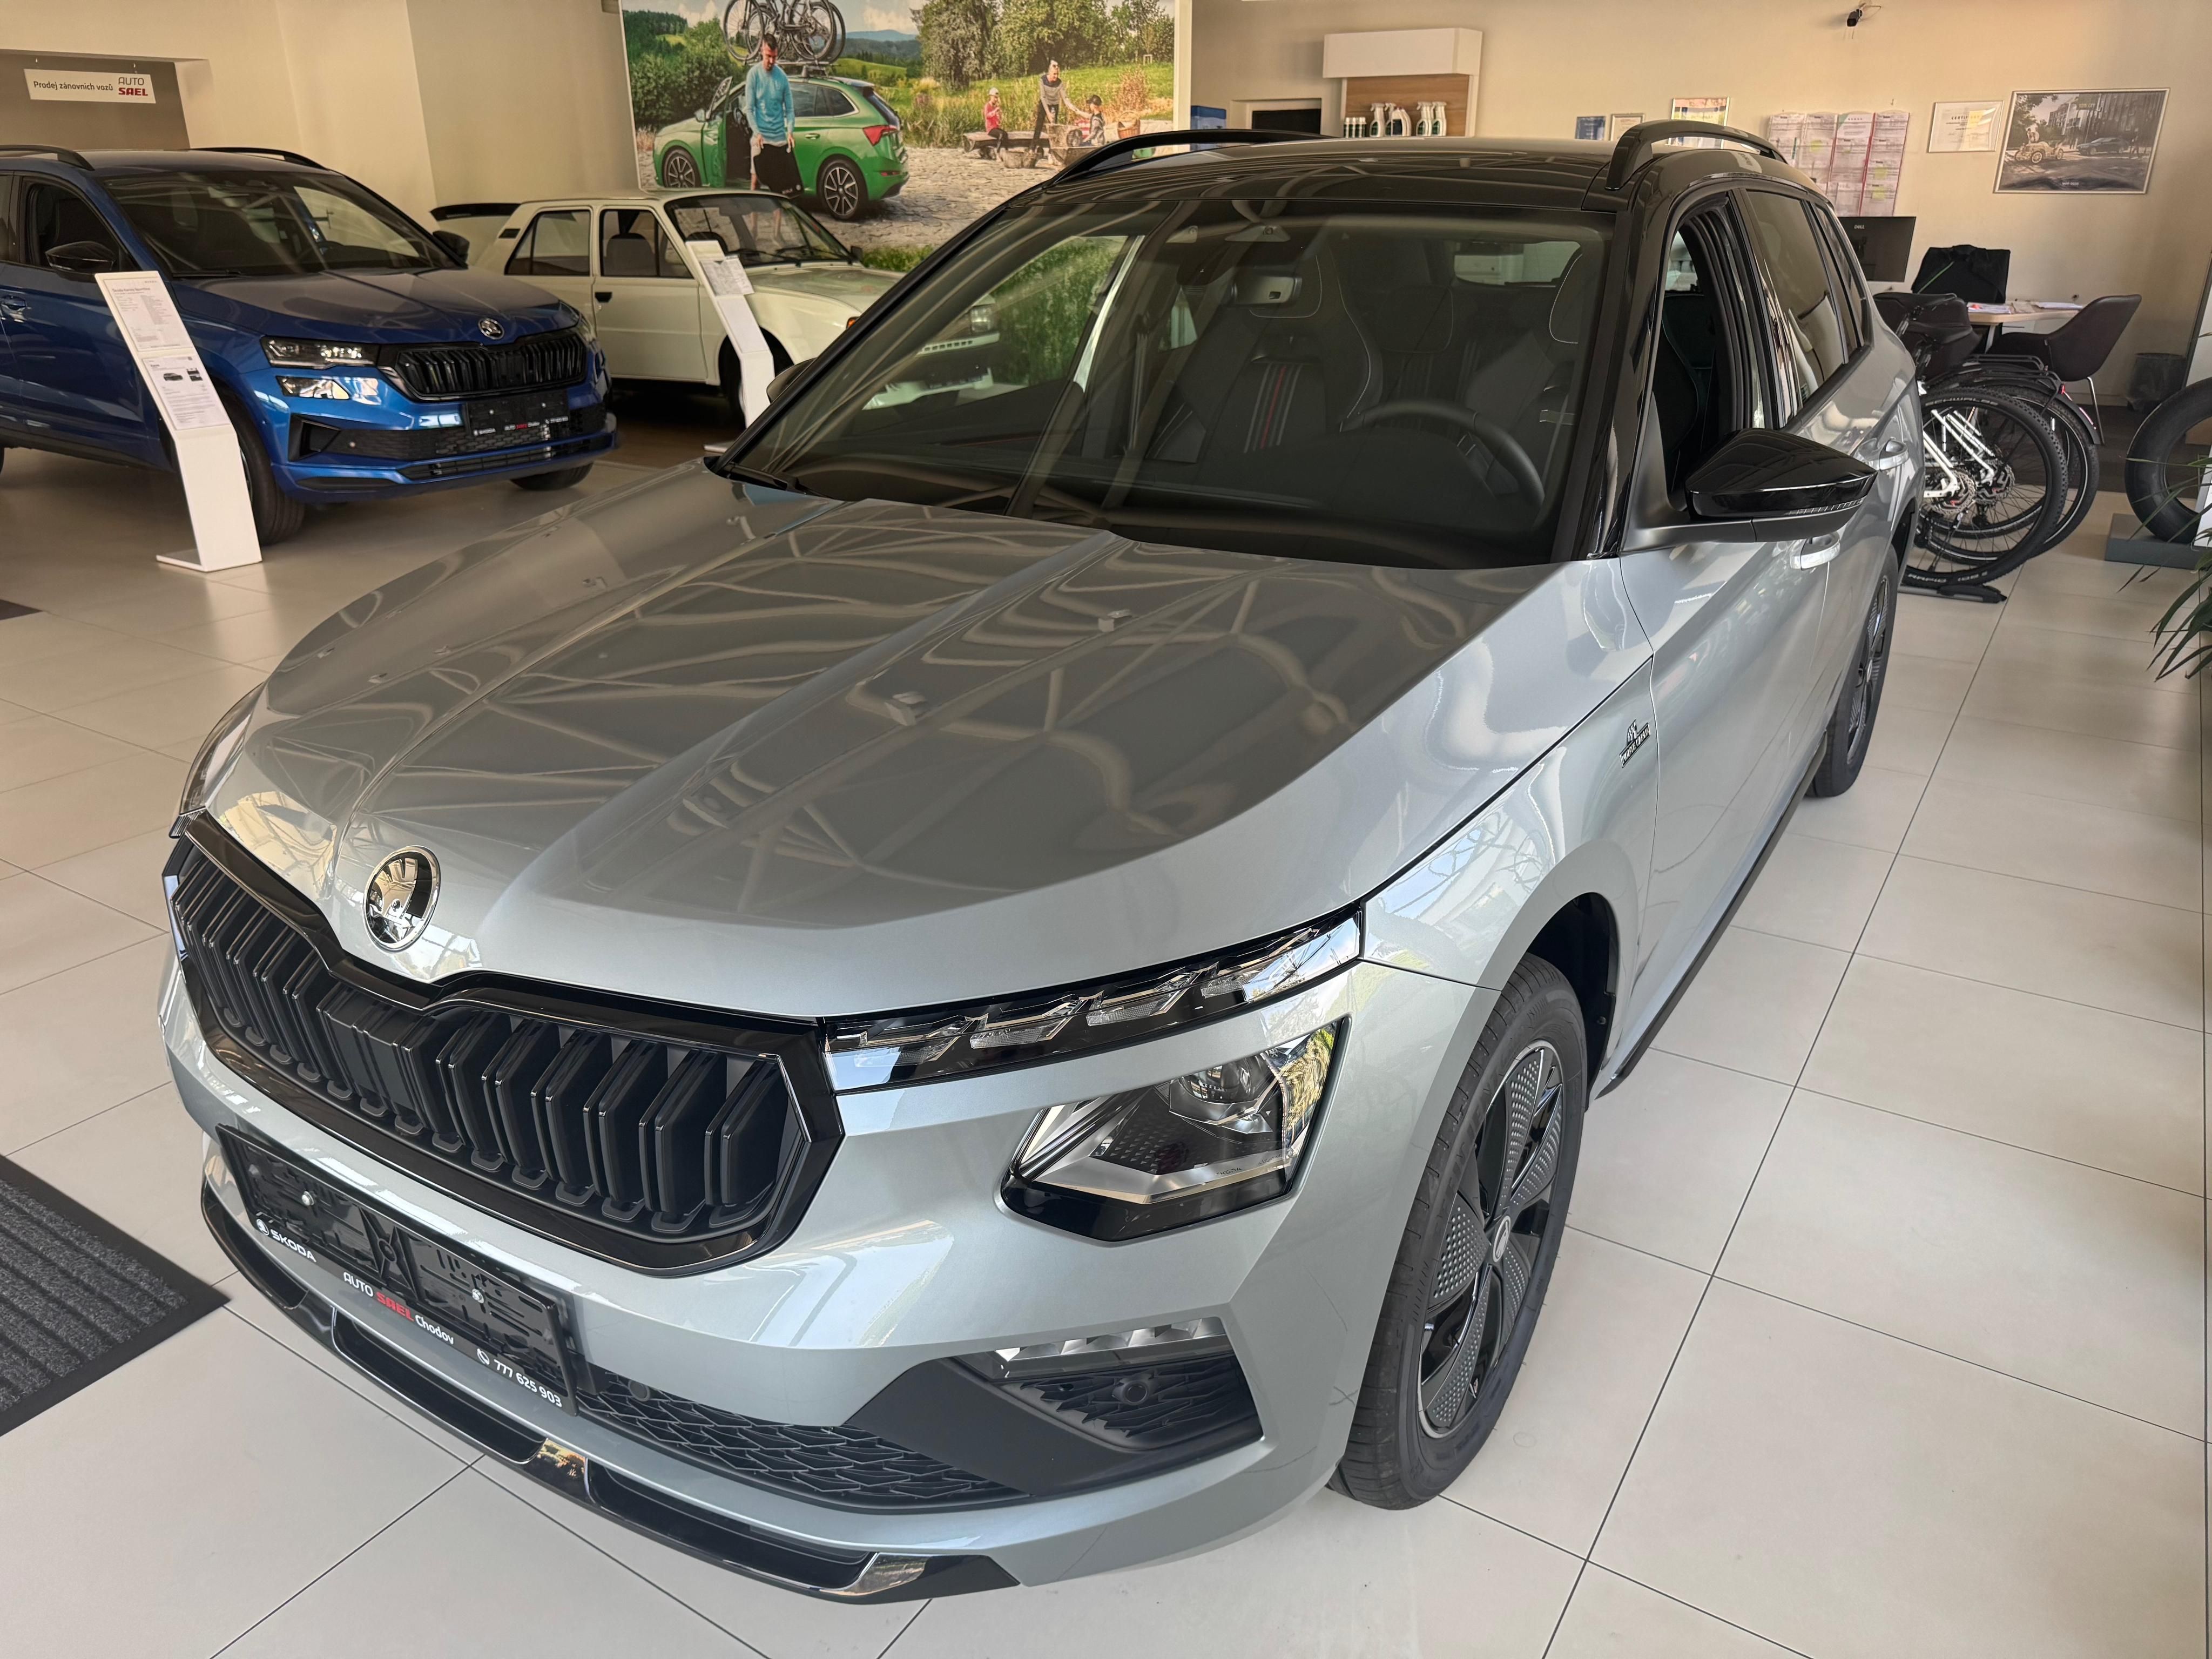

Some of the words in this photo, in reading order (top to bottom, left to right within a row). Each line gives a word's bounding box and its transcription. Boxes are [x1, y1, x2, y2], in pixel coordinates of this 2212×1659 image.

[33, 81, 58, 90] Prodej
[59, 82, 95, 90] zánovních
[118, 77, 144, 85] AUTO
[118, 87, 149, 96] SAEL
[343, 1272, 374, 1297] AUTO
[376, 1292, 415, 1321] SAEL
[415, 1314, 454, 1345] Chodov
[494, 1359, 513, 1378] 777
[516, 1372, 537, 1393] 625
[538, 1386, 562, 1408] 903
